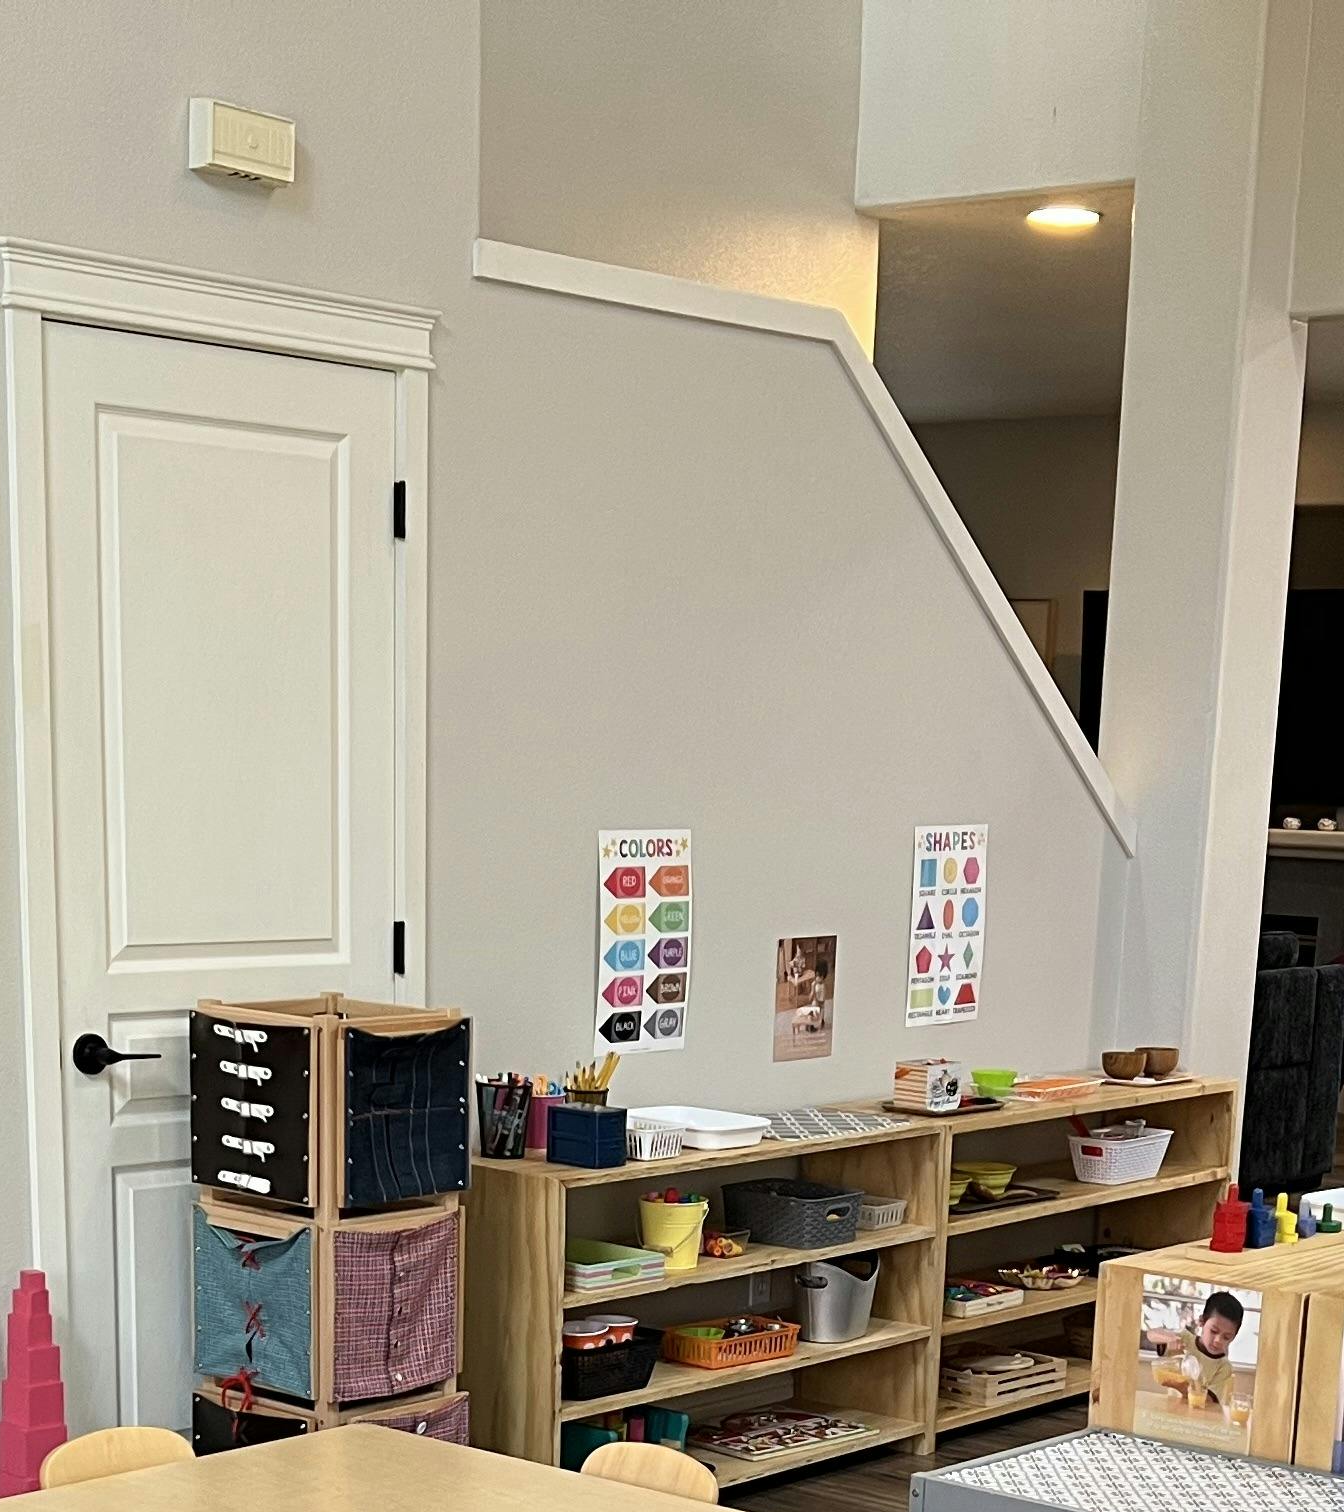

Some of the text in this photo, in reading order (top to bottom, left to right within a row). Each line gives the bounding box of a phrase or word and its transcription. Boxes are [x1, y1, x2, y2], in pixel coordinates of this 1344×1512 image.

[619, 838, 673, 858] COLORS
[925, 831, 976, 852] SHAPES
[622, 875, 637, 888] RED
[620, 949, 637, 961] BLUE
[618, 985, 637, 998] PINK
[935, 1008, 950, 1016] HEART
[615, 1020, 634, 1032] BLACK
